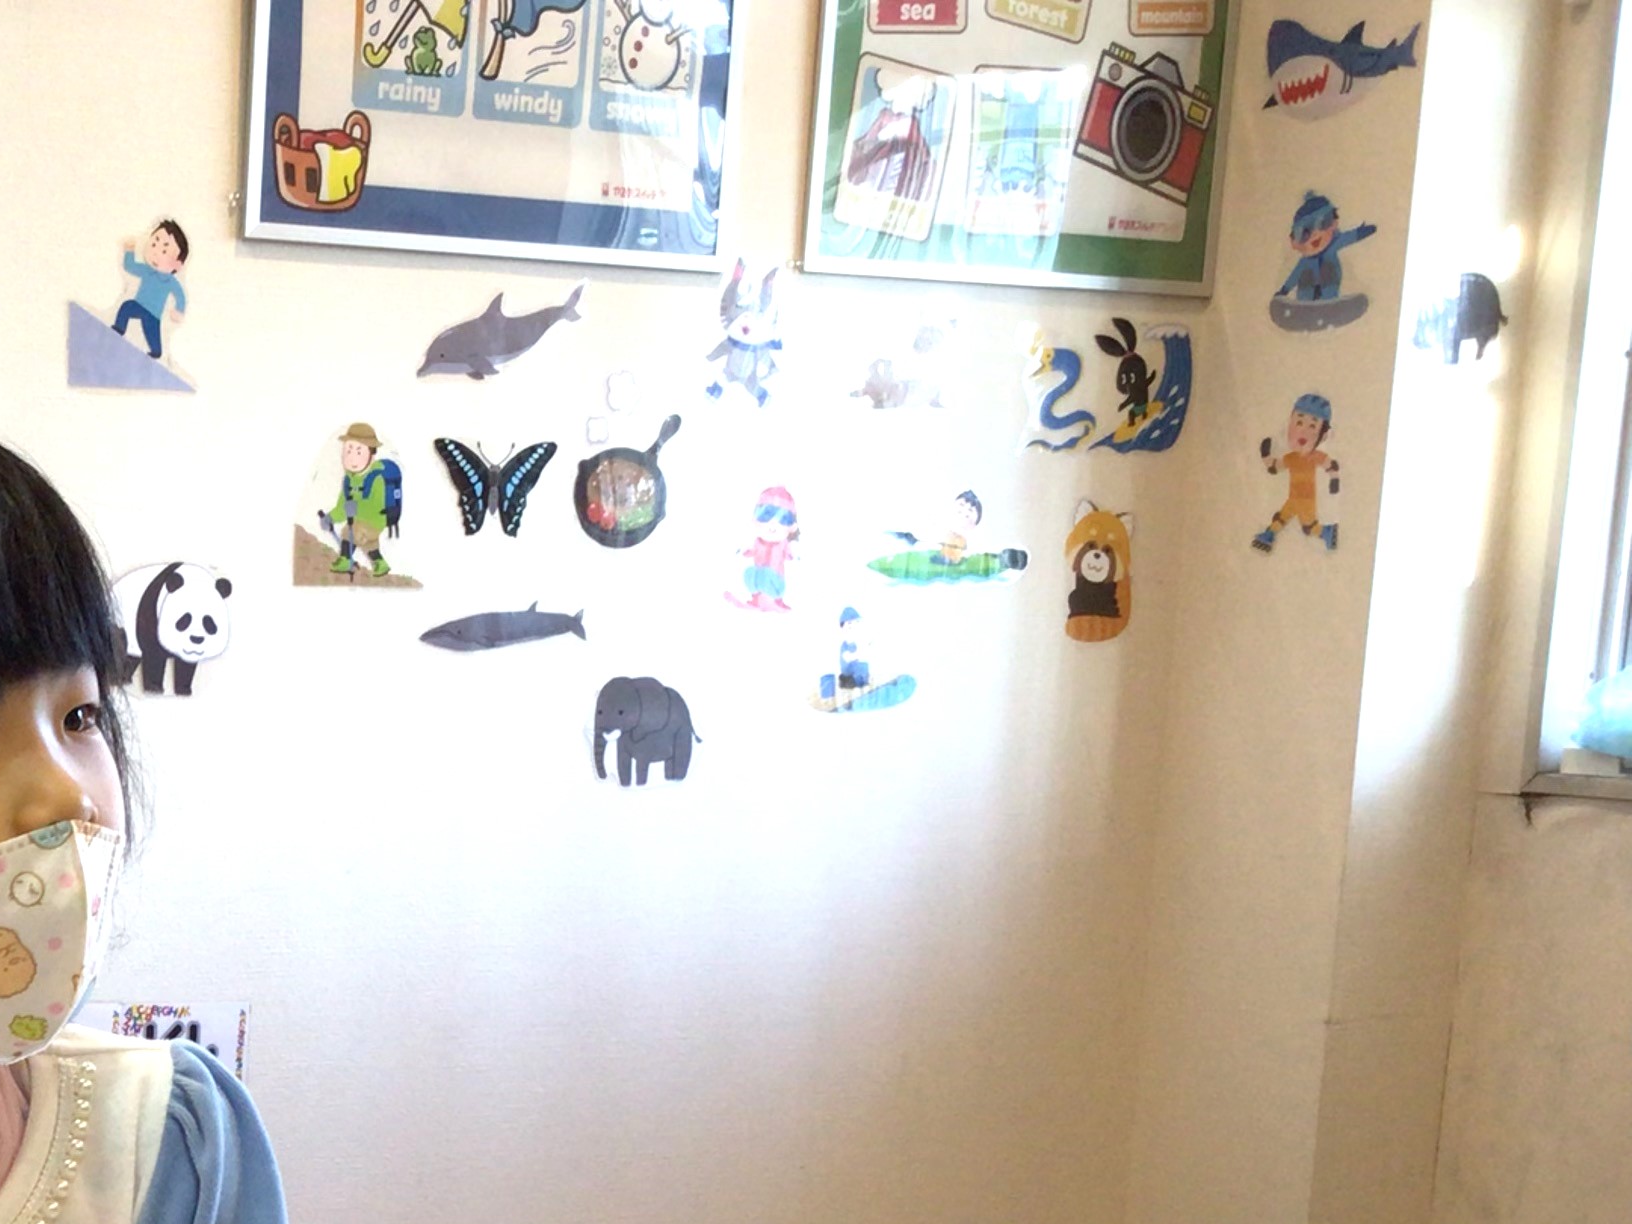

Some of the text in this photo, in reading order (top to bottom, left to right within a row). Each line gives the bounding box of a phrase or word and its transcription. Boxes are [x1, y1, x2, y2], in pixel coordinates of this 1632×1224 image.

[899, 2, 936, 21] sea
[1007, 0, 1068, 29] forest
[1140, 8, 1204, 25] mountain
[377, 77, 442, 112] rainy
[493, 86, 564, 122] windy
